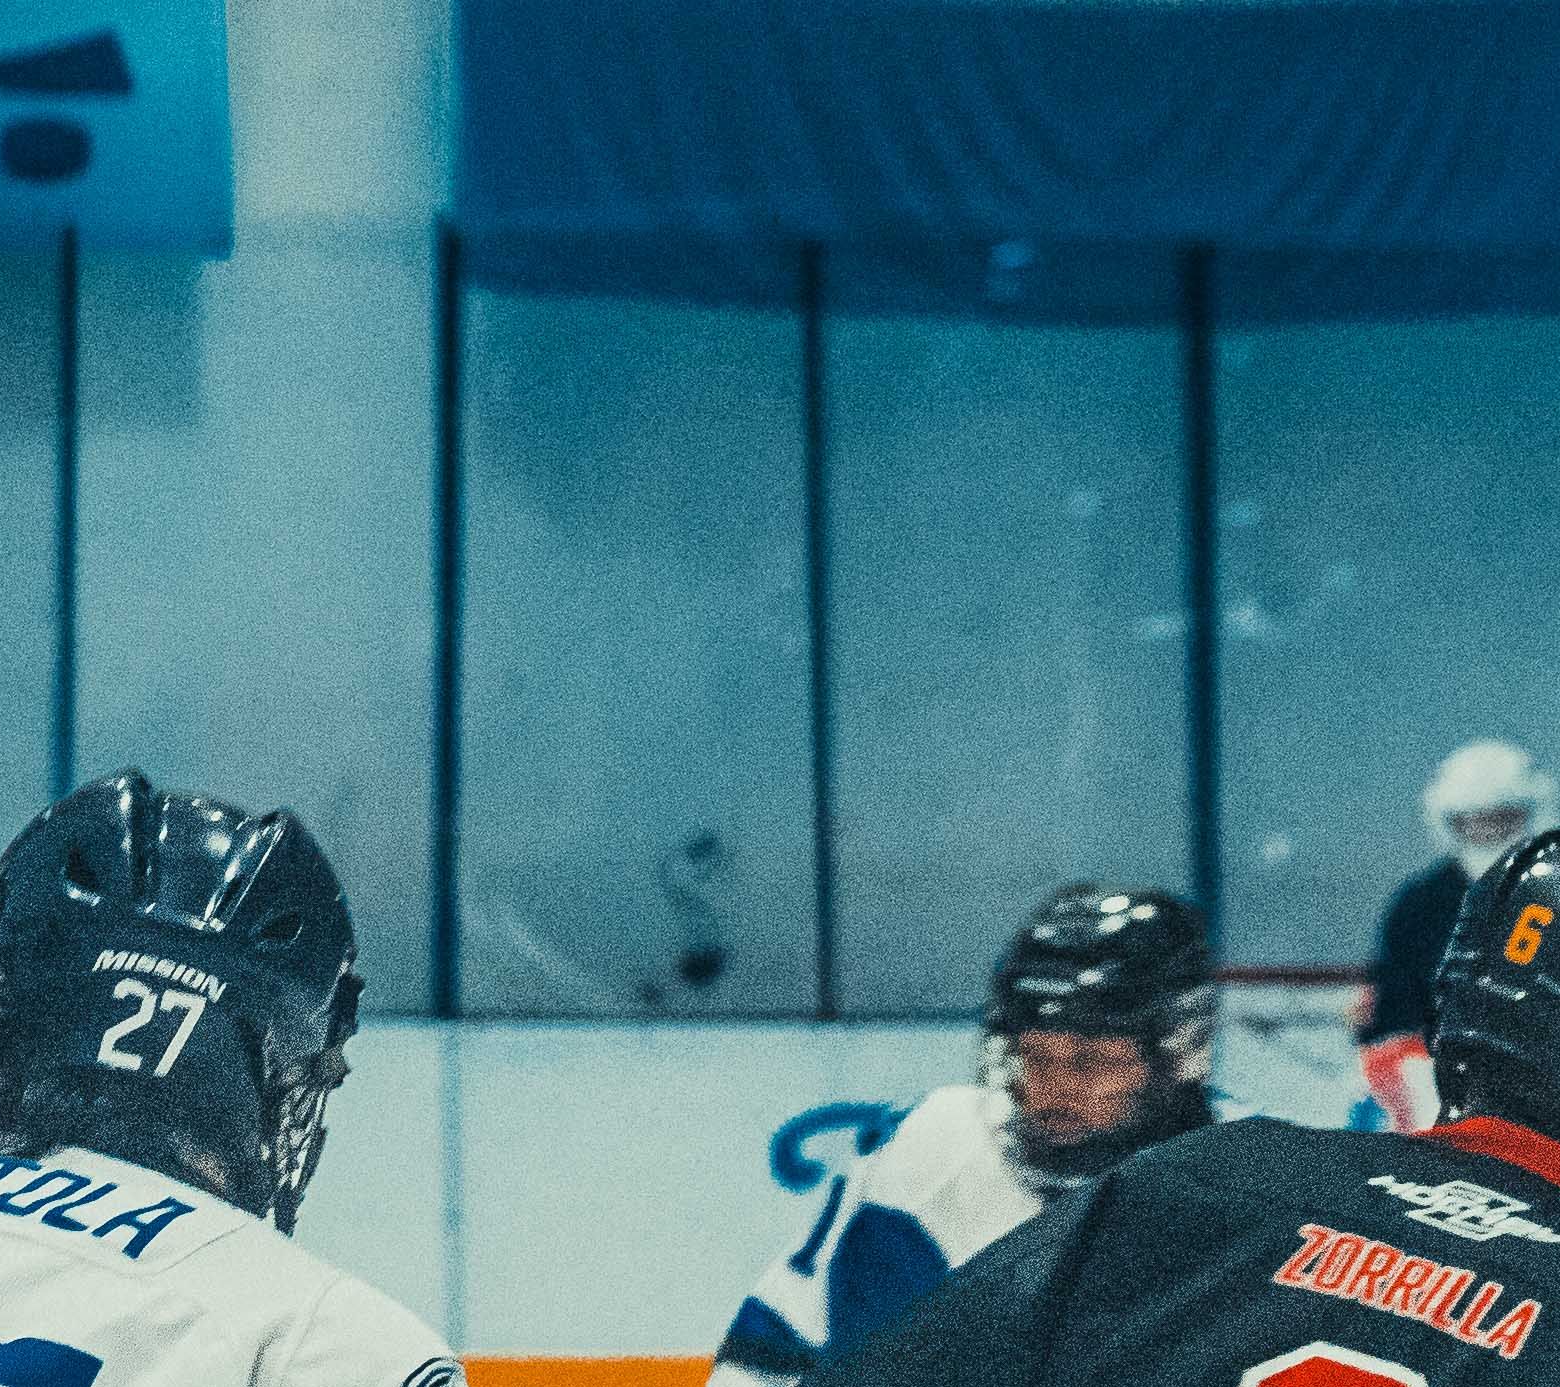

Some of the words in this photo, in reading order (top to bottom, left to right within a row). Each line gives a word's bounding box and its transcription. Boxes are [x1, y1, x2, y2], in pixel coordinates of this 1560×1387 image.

[1504, 903, 1554, 965] 6
[97, 977, 207, 1077] 27
[1273, 1224, 1543, 1360] ZORRILLA
